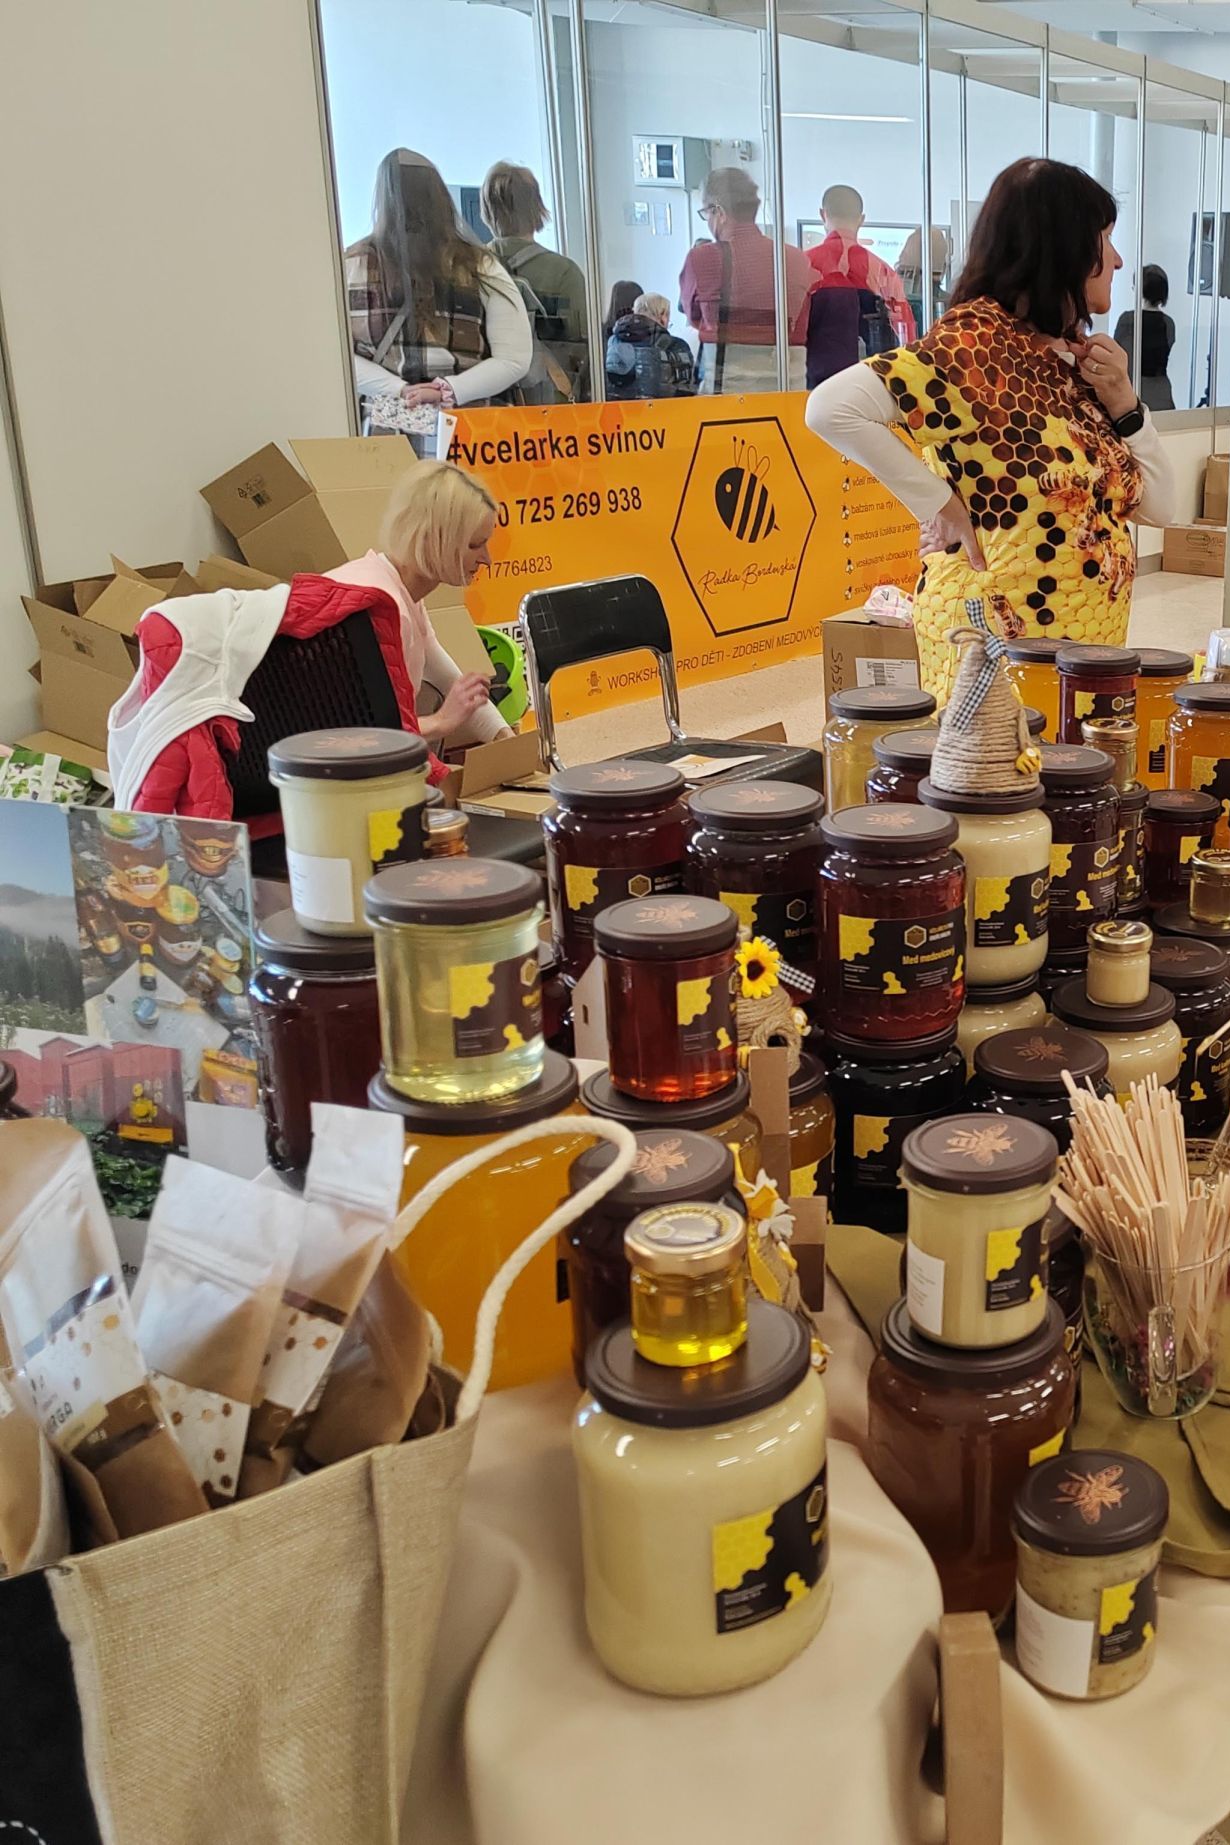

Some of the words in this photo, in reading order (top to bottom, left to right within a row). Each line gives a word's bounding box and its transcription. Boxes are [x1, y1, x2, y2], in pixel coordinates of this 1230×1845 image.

[446, 430, 579, 466] #vcelarka
[587, 424, 666, 456] svinov
[515, 495, 555, 525] 725
[562, 491, 601, 519] 269
[607, 486, 642, 514] 938
[486, 555, 553, 580] 17764823
[608, 667, 663, 690] WORKSH
[676, 656, 699, 673] PRO
[701, 649, 724, 666] DĚTI
[732, 636, 775, 659] ZDOBENÍ
